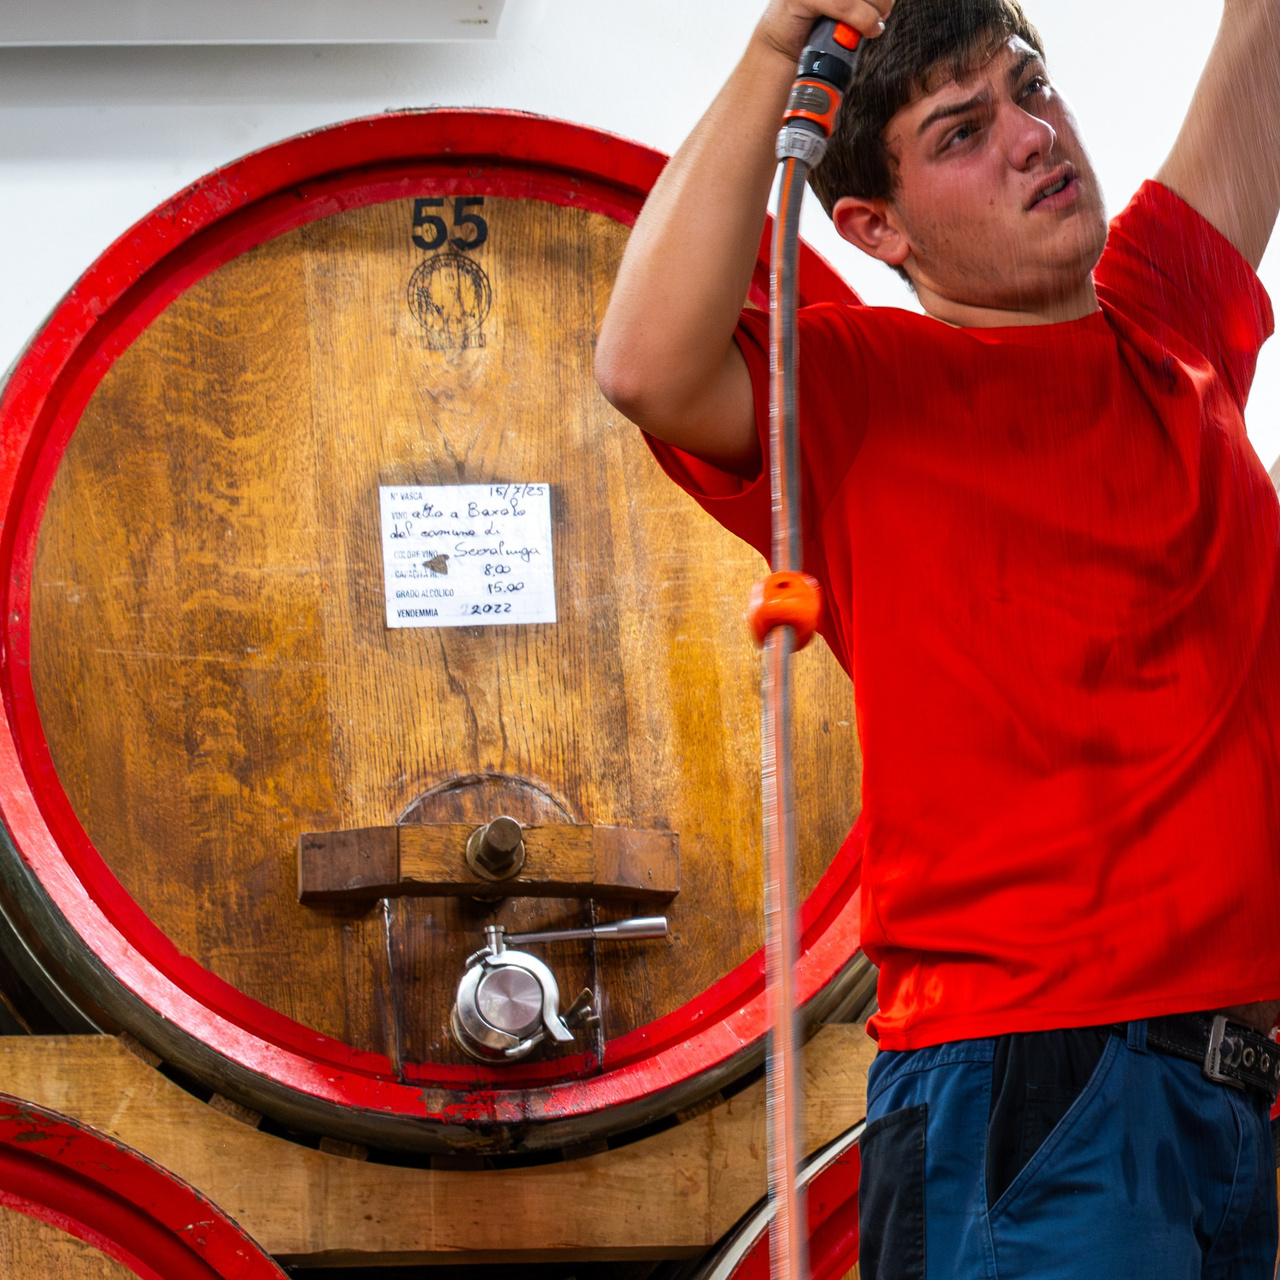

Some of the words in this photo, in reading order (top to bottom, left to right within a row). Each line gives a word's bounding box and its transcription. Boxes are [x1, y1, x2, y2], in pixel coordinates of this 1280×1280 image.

[412, 196, 488, 251] 55
[400, 491, 423, 501] VASCA
[391, 511, 408, 520] VINO
[450, 511, 459, 519] a
[484, 520, 500, 536] di
[393, 550, 420, 560] COLORE
[421, 549, 438, 559] VINO
[396, 589, 420, 599] GRADO
[421, 588, 455, 598] ALCOLICO
[397, 608, 439, 618] VENDEMMIA
[471, 602, 512, 615] 2022
